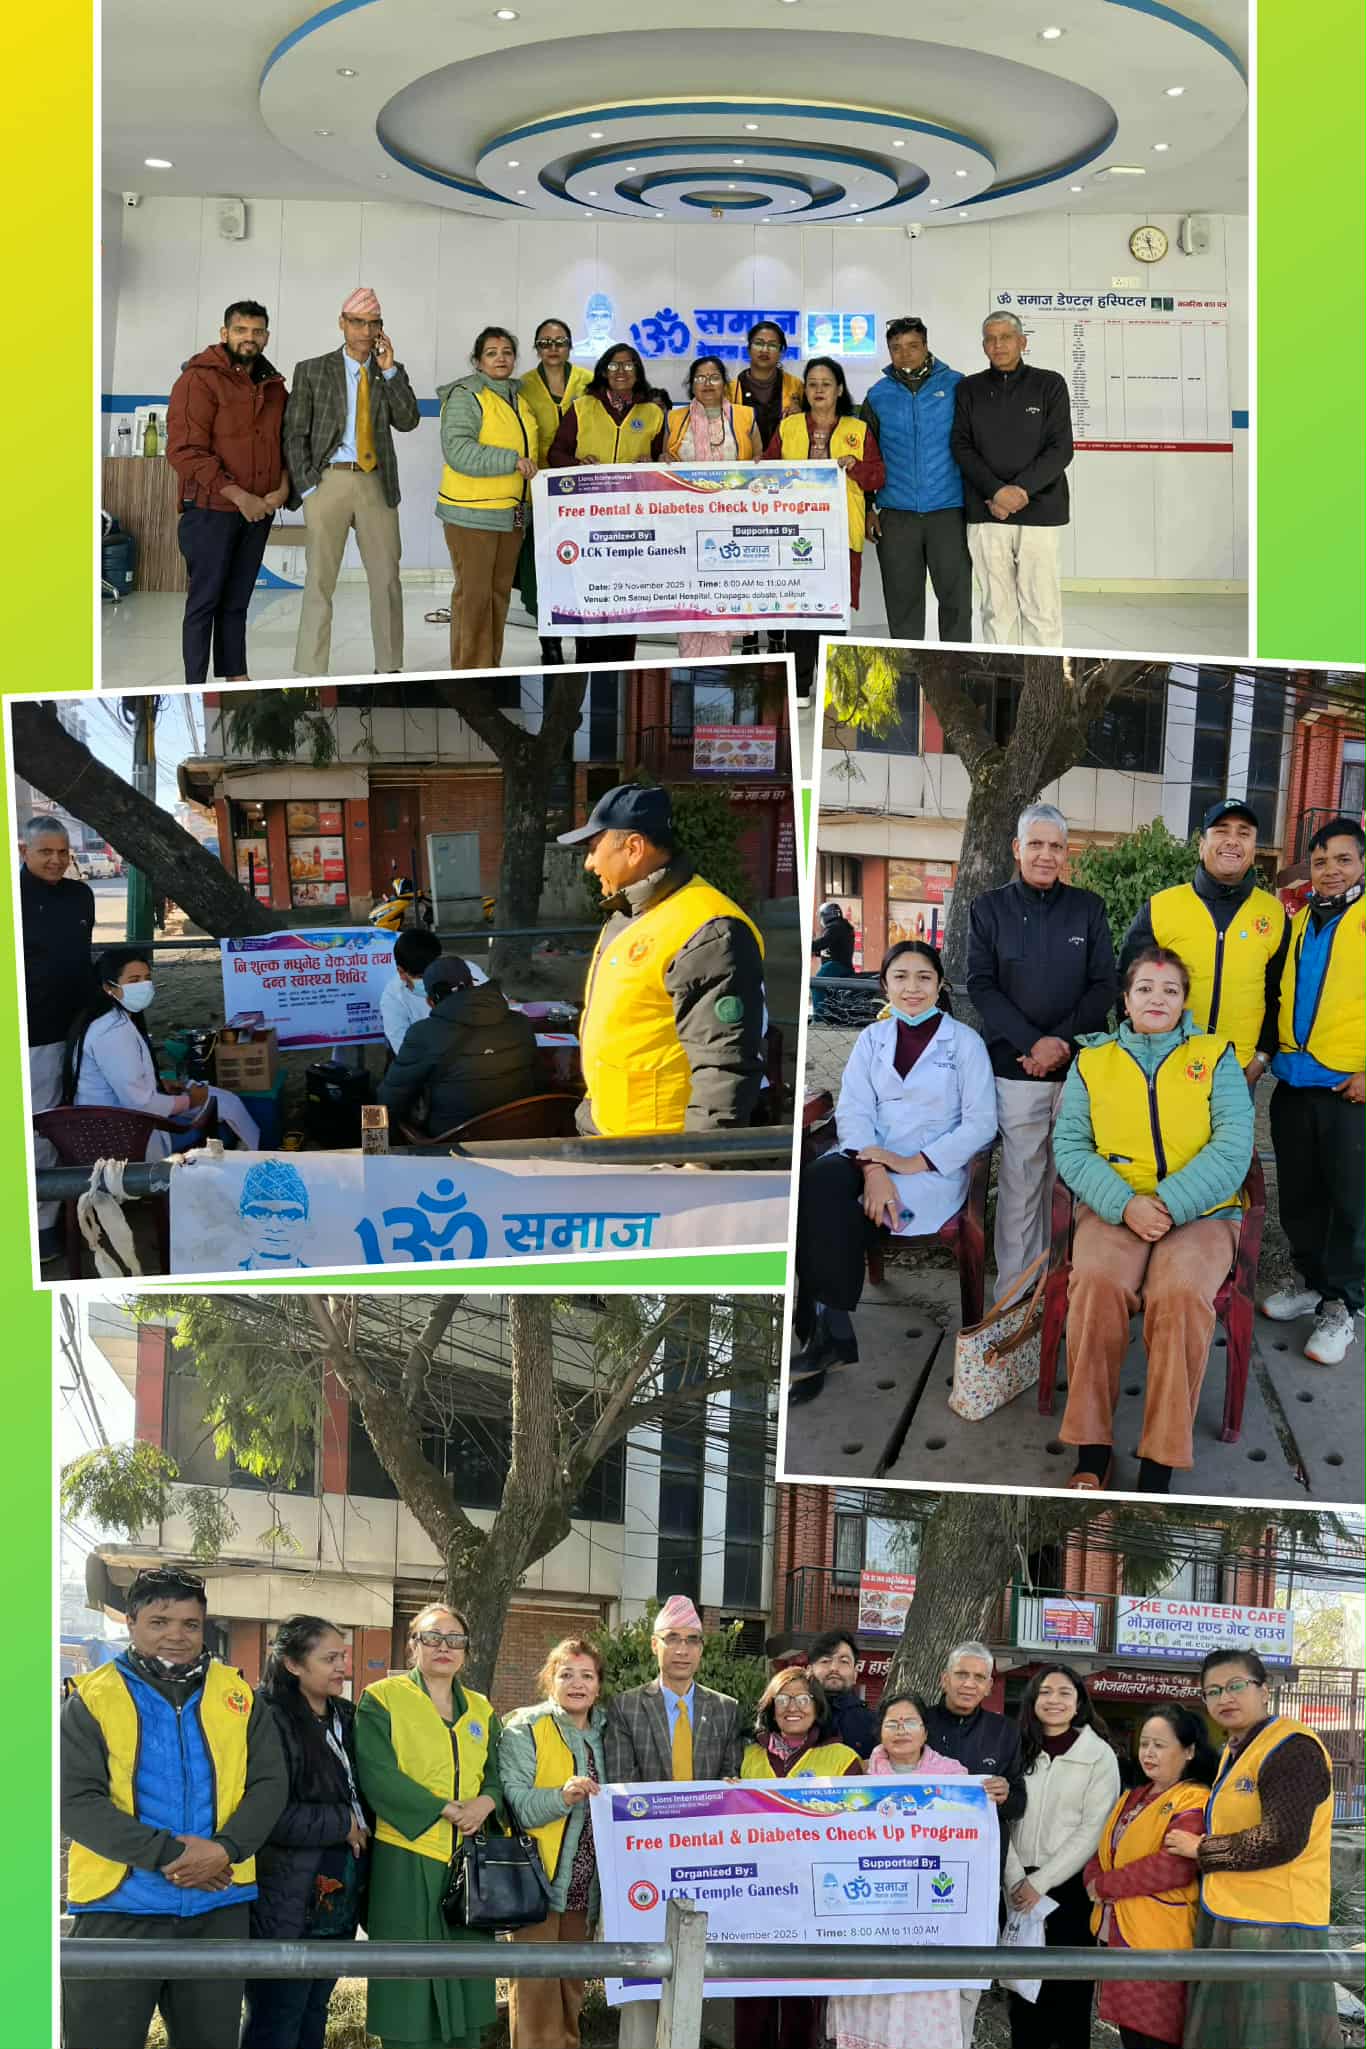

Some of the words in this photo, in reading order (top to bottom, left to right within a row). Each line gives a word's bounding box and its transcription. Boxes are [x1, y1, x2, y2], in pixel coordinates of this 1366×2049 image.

[1017, 295, 1054, 305] समाज
[1057, 292, 1094, 306] डेण्टल
[1098, 293, 1146, 308] हस्पिटल
[558, 505, 585, 517] Free
[590, 503, 631, 516] Dental
[635, 503, 645, 515] &
[648, 501, 705, 515] Diabetes
[709, 501, 748, 513] Check
[752, 501, 769, 515] Up
[773, 500, 830, 515] Program
[592, 532, 636, 542] Organized
[638, 531, 653, 541] By:
[735, 526, 780, 536] Supported
[782, 525, 796, 536] By:
[581, 546, 602, 558] LCK
[605, 546, 644, 559] Temple
[648, 545, 686, 556] Ganesh
[588, 583, 610, 591] Date:
[625, 582, 664, 590] November
[666, 581, 685, 589] 2025
[698, 580, 721, 588] Time:
[767, 579, 787, 587] 11:00
[788, 579, 801, 587] AM
[583, 595, 610, 603] Venue:
[613, 594, 627, 602] Om
[653, 593, 678, 601] Dental
[502, 1211, 661, 1251] समाज
[1129, 1599, 1161, 1614] THE
[1167, 1602, 1243, 1620] CANTEEN
[1247, 1610, 1287, 1623] CAFE
[1128, 1615, 1193, 1632] भोजनालय
[1198, 1622, 1222, 1633] एण्ड
[1254, 1627, 1285, 1640] हाउस
[1118, 1672, 1132, 1681] The
[652, 1795, 673, 1804] Lions
[673, 1791, 724, 1802] International
[626, 1834, 663, 1851] Free
[669, 1830, 724, 1848] Dental
[730, 1829, 742, 1845] &
[747, 1826, 821, 1845] Diabetes
[826, 1825, 877, 1841] Check
[883, 1824, 905, 1842] Up
[911, 1824, 979, 1843] Program
[862, 1857, 919, 1870] Supported
[921, 1857, 937, 1869] By:
[675, 1867, 732, 1880] Organized
[735, 1866, 753, 1879] By:
[661, 1886, 690, 1902] LCK
[694, 1884, 743, 1901] Temple
[748, 1882, 799, 1897] Ganesh
[874, 1881, 909, 1893] समाज
[705, 1932, 718, 1941] 29
[721, 1931, 771, 1941] November
[773, 1930, 798, 1939] 2025
[816, 1928, 847, 1937] Time:
[850, 1927, 873, 1937] 8:00
[874, 1927, 890, 1936] AM
[892, 1927, 900, 1935] to
[903, 1926, 923, 1936] 11:00
[926, 1926, 940, 1935] AM
